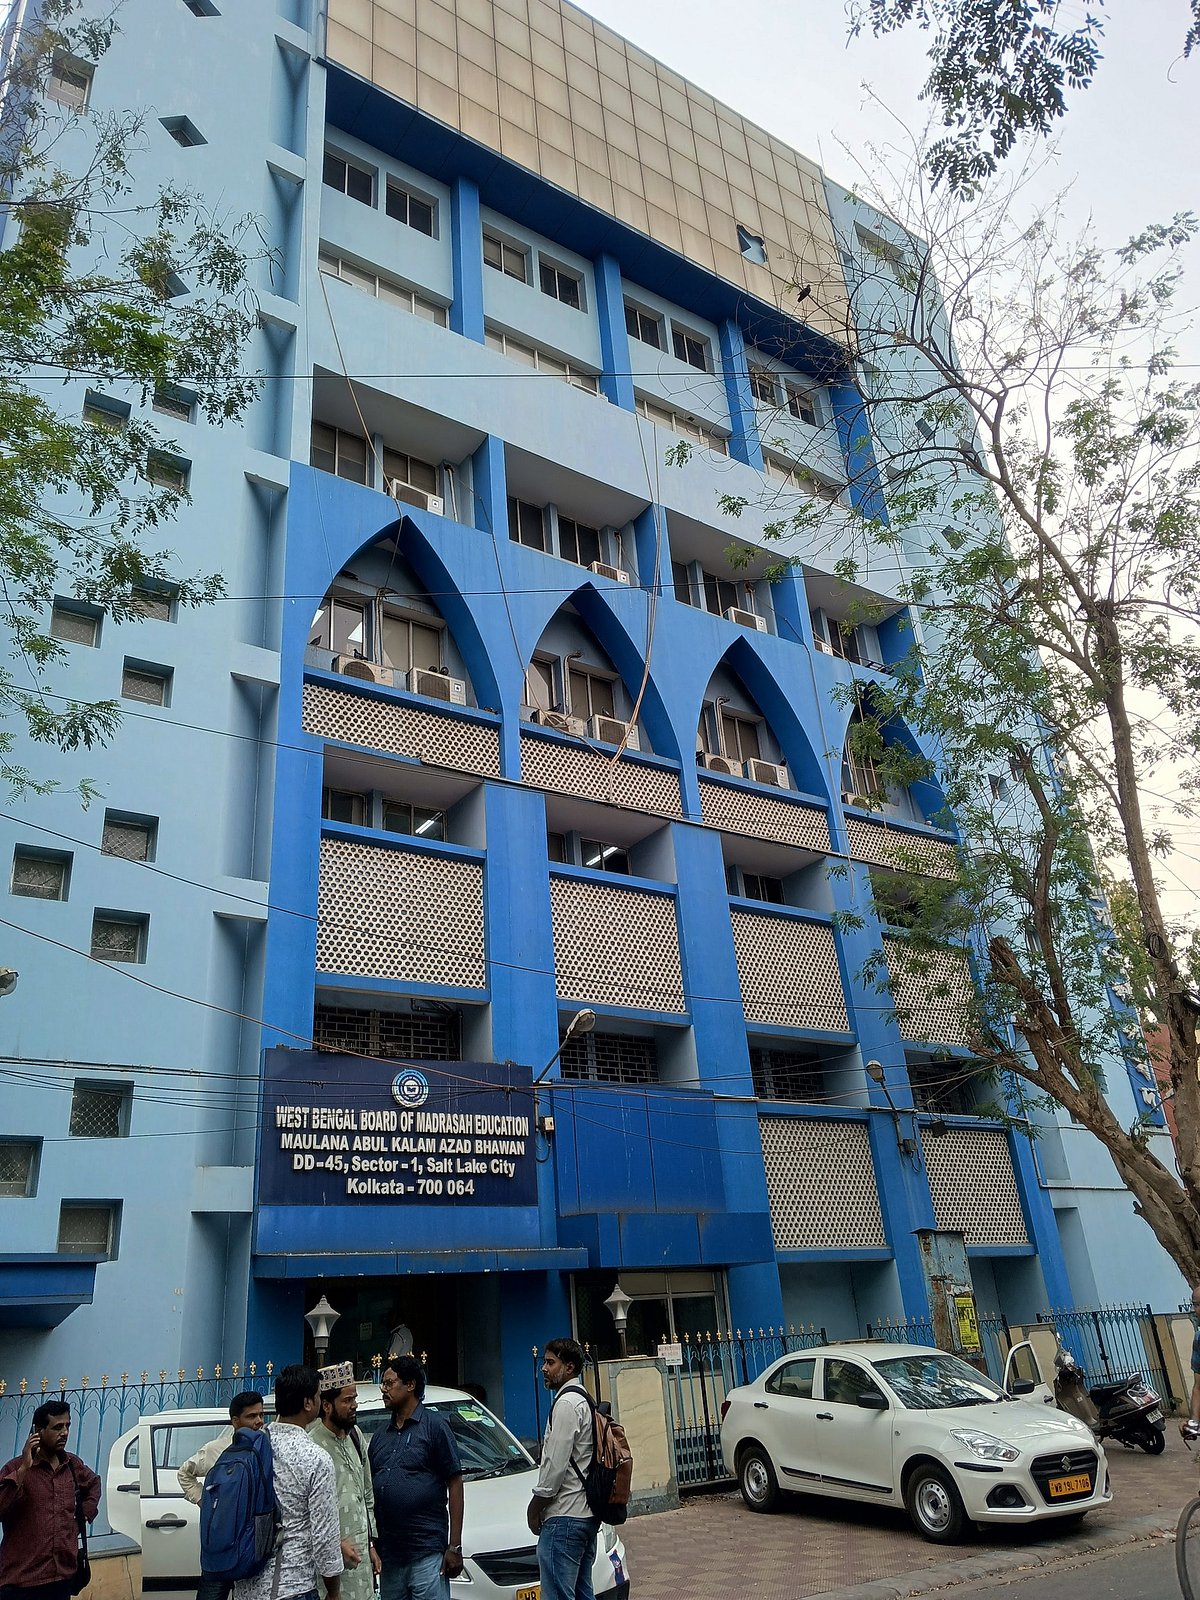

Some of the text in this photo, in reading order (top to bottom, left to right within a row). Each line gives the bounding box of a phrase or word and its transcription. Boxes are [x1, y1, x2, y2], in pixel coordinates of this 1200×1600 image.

[276, 1106, 529, 1137] WEST BENGAL BOARD OF MADRASAH EDUCATION
[281, 1133, 525, 1155] MAULANA ABUL KALAM AZAD BHAWAN
[426, 1158, 453, 1173] Salt
[456, 1158, 487, 1173] Lake
[490, 1159, 516, 1177] City
[417, 1179, 443, 1195] 700
[447, 1179, 475, 1195] 064
